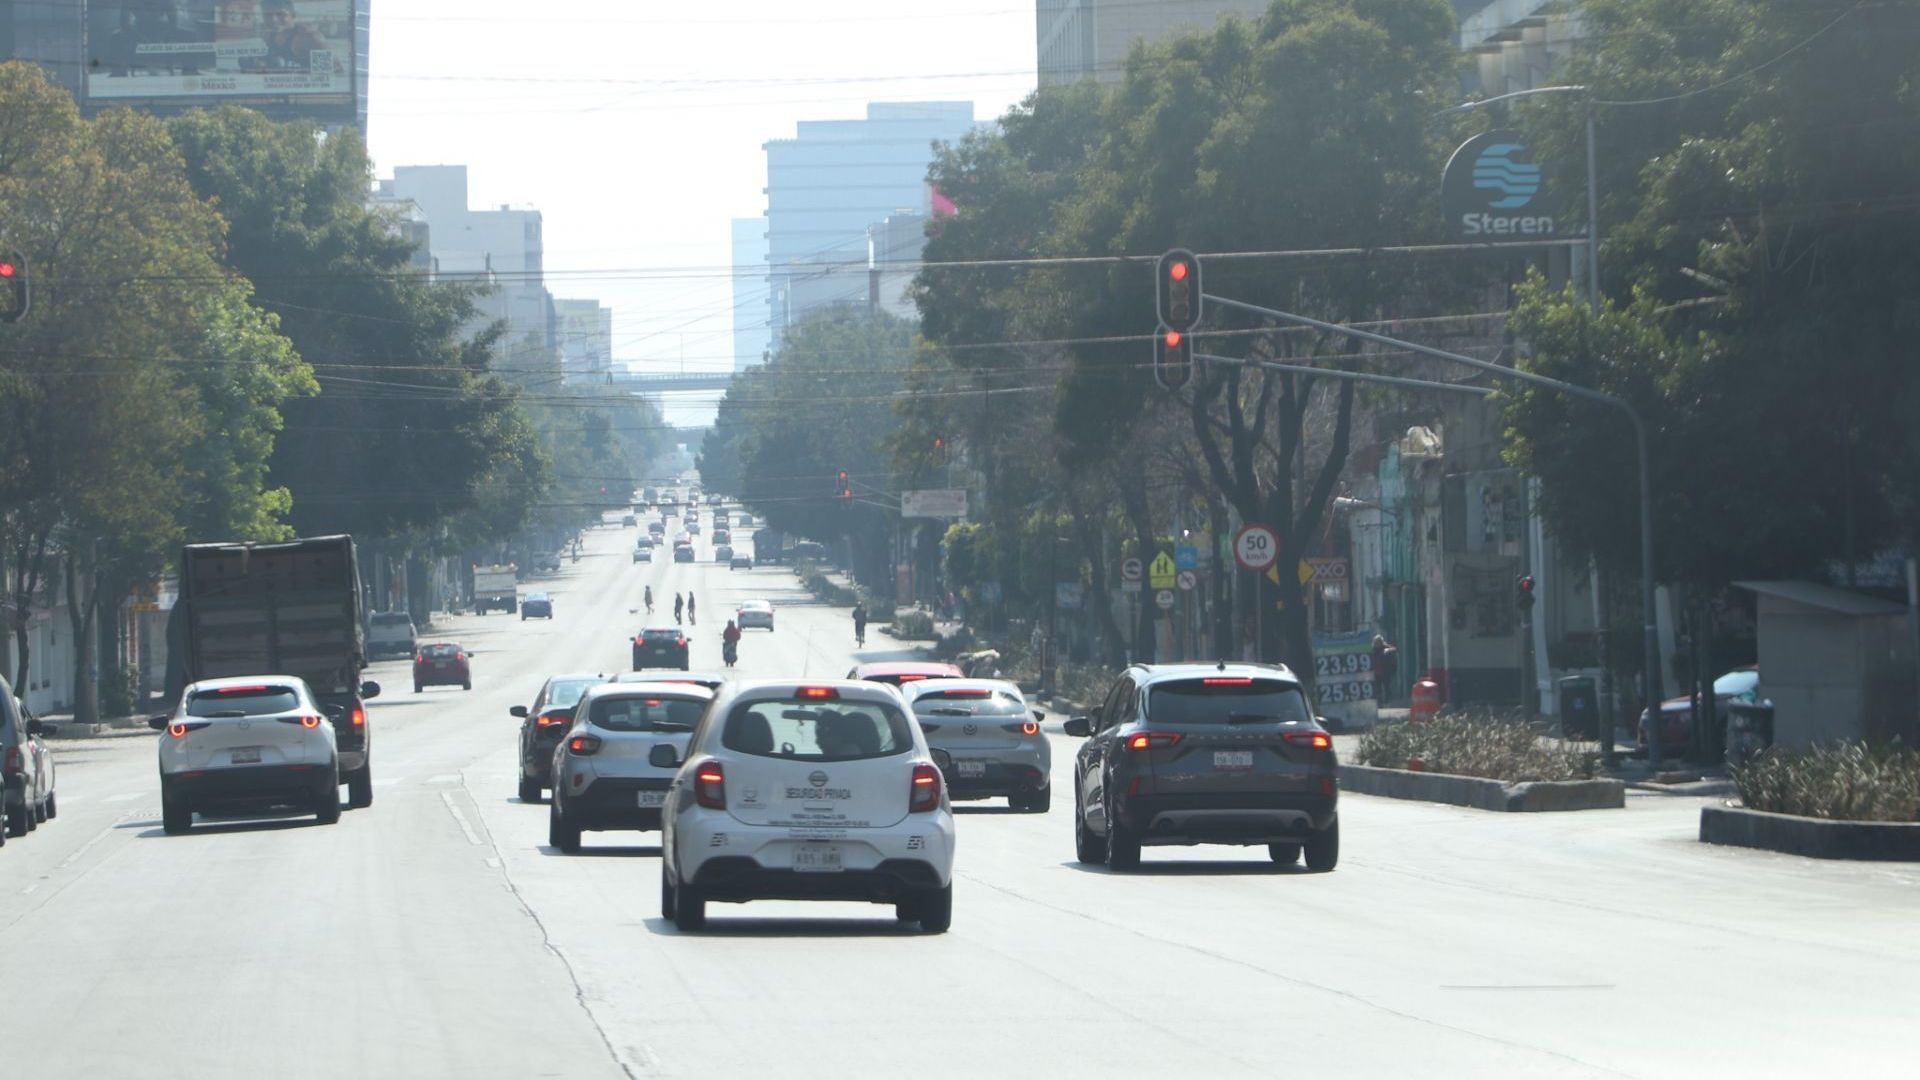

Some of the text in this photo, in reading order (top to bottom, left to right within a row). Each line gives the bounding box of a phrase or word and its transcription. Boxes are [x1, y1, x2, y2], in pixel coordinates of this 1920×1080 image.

[1461, 212, 1553, 235] Steren
[1246, 534, 1268, 551] 50
[1246, 550, 1268, 560] km/h
[1312, 561, 1346, 578] XXO
[1317, 653, 1371, 675] 23.99
[1320, 682, 1373, 703] 25.99
